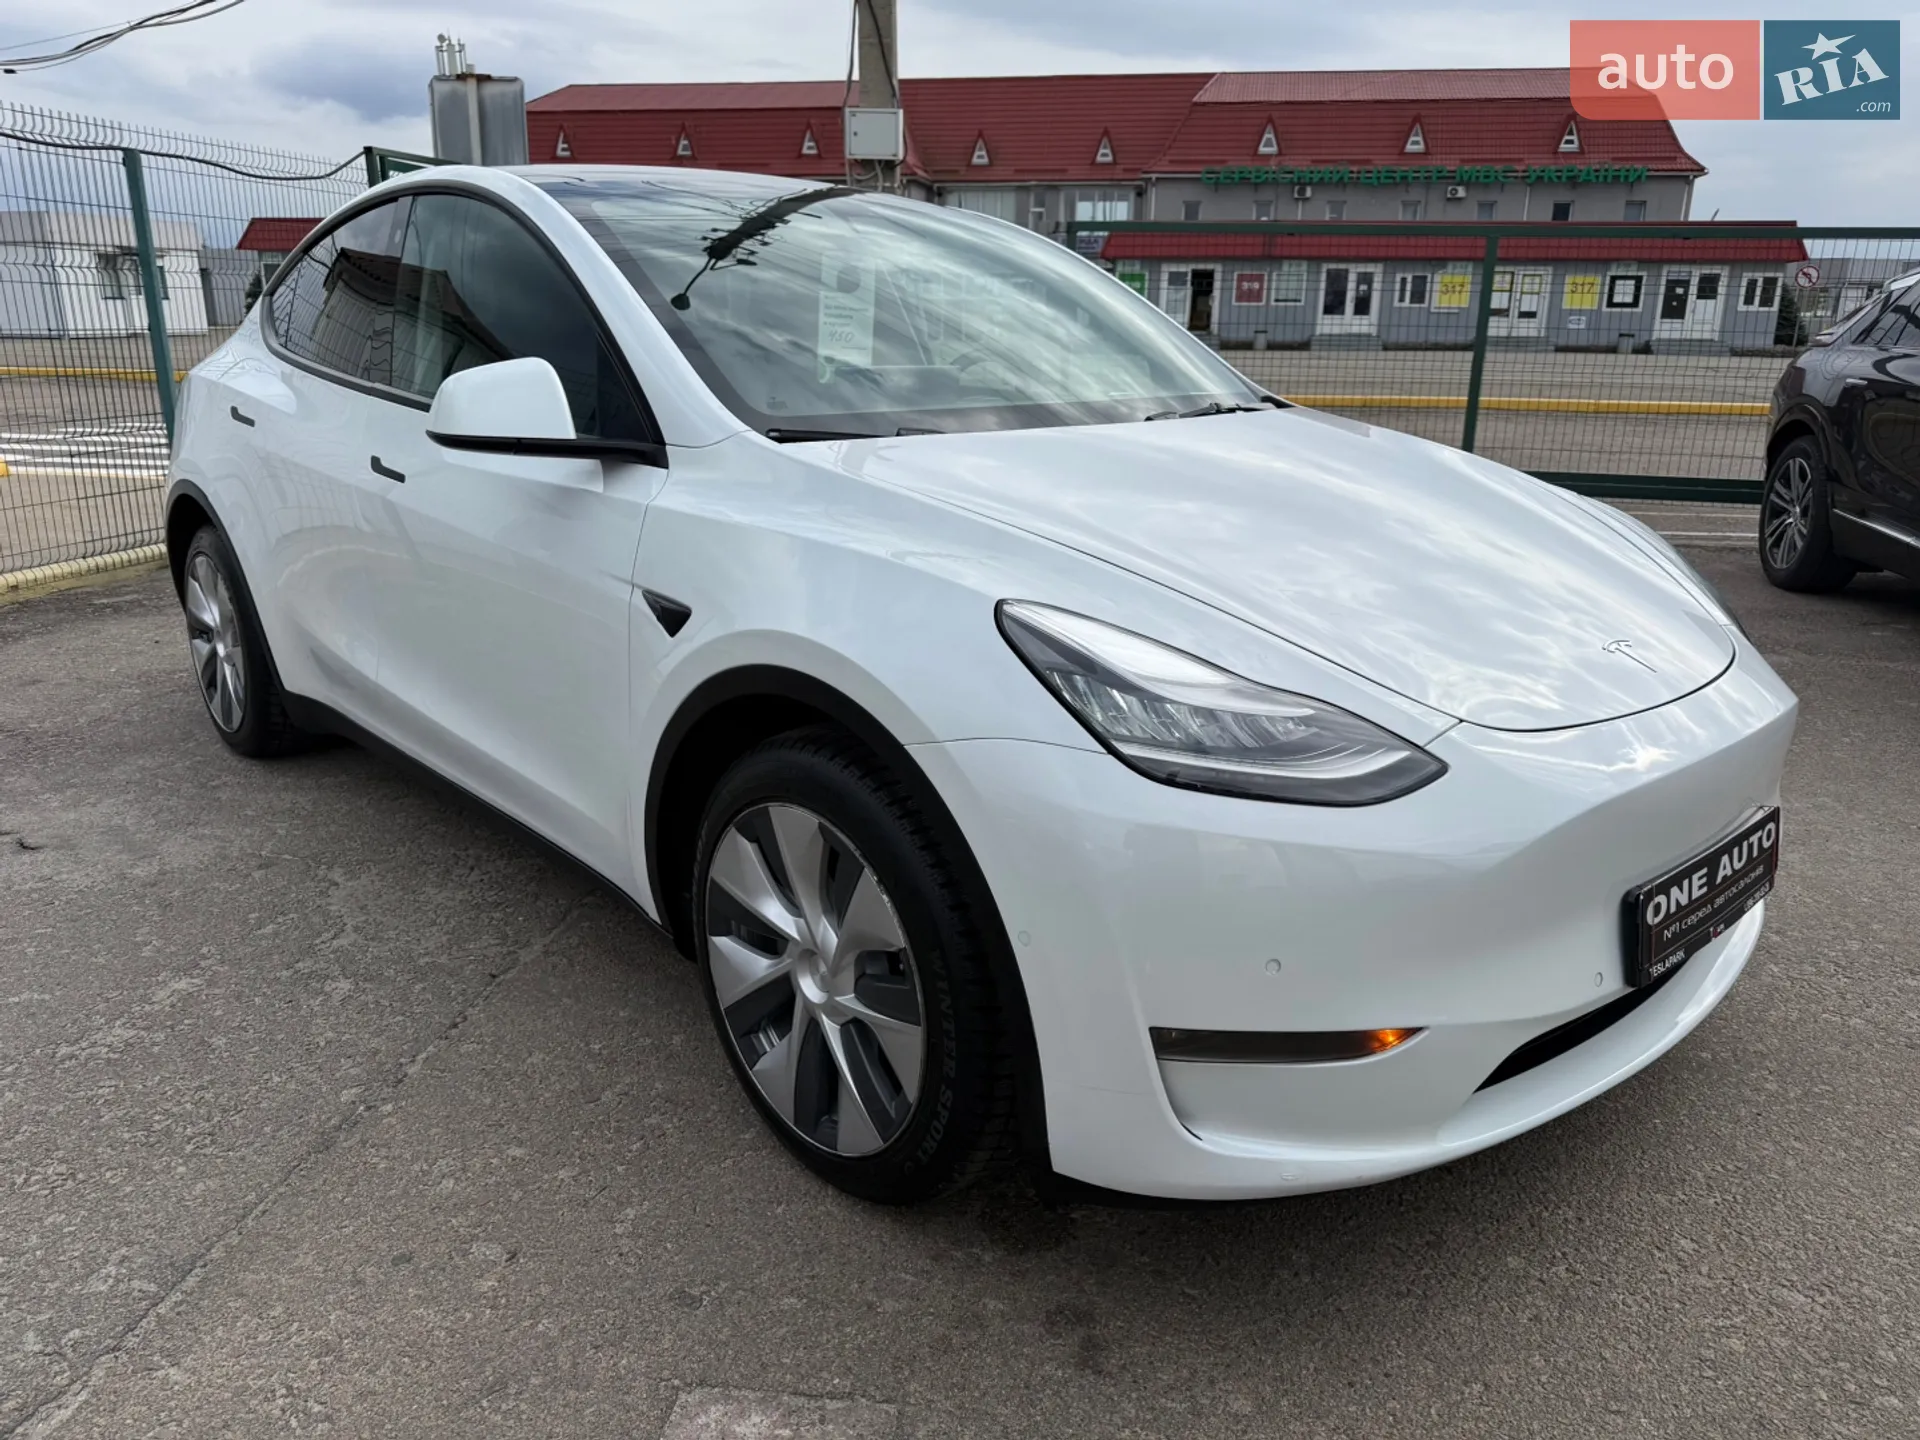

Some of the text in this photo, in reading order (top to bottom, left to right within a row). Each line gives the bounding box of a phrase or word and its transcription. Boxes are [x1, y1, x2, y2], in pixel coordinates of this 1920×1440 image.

[1201, 162, 1648, 186] СЕРВІСНИЙ ЦЕНТР МВС УКРАЇНИ
[1570, 281, 1595, 294] 317
[1646, 867, 1708, 926] ONE
[1716, 822, 1776, 884] AUTO
[1649, 950, 1686, 979] TESLAPARK
[918, 947, 956, 1165] WINTER SPORT
